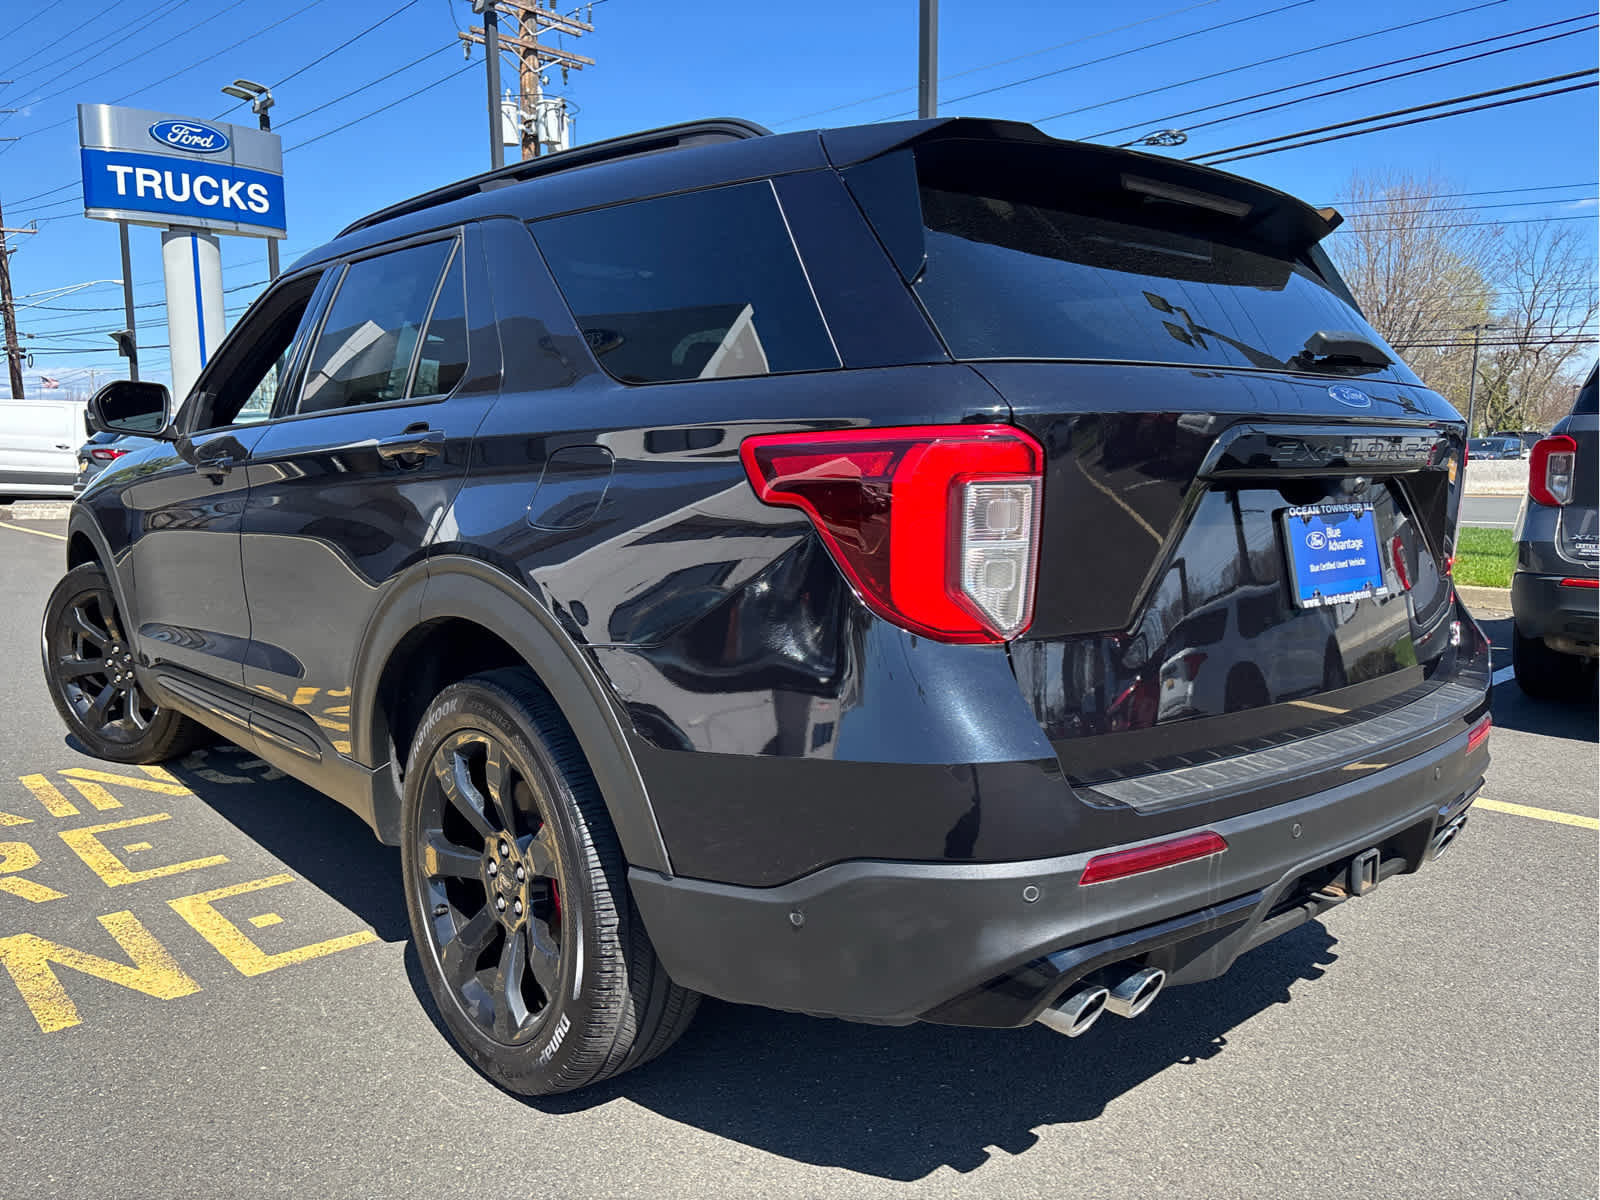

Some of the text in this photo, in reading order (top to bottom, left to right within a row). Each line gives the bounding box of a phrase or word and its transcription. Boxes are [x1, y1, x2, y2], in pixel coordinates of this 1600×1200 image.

[166, 122, 215, 150] Ford
[106, 164, 271, 214] TRUCKS
[1288, 506, 1321, 516] OCEAN
[1321, 502, 1363, 513] TOWNSHIP
[1326, 527, 1341, 538] Blue
[1328, 538, 1363, 551] Advantage
